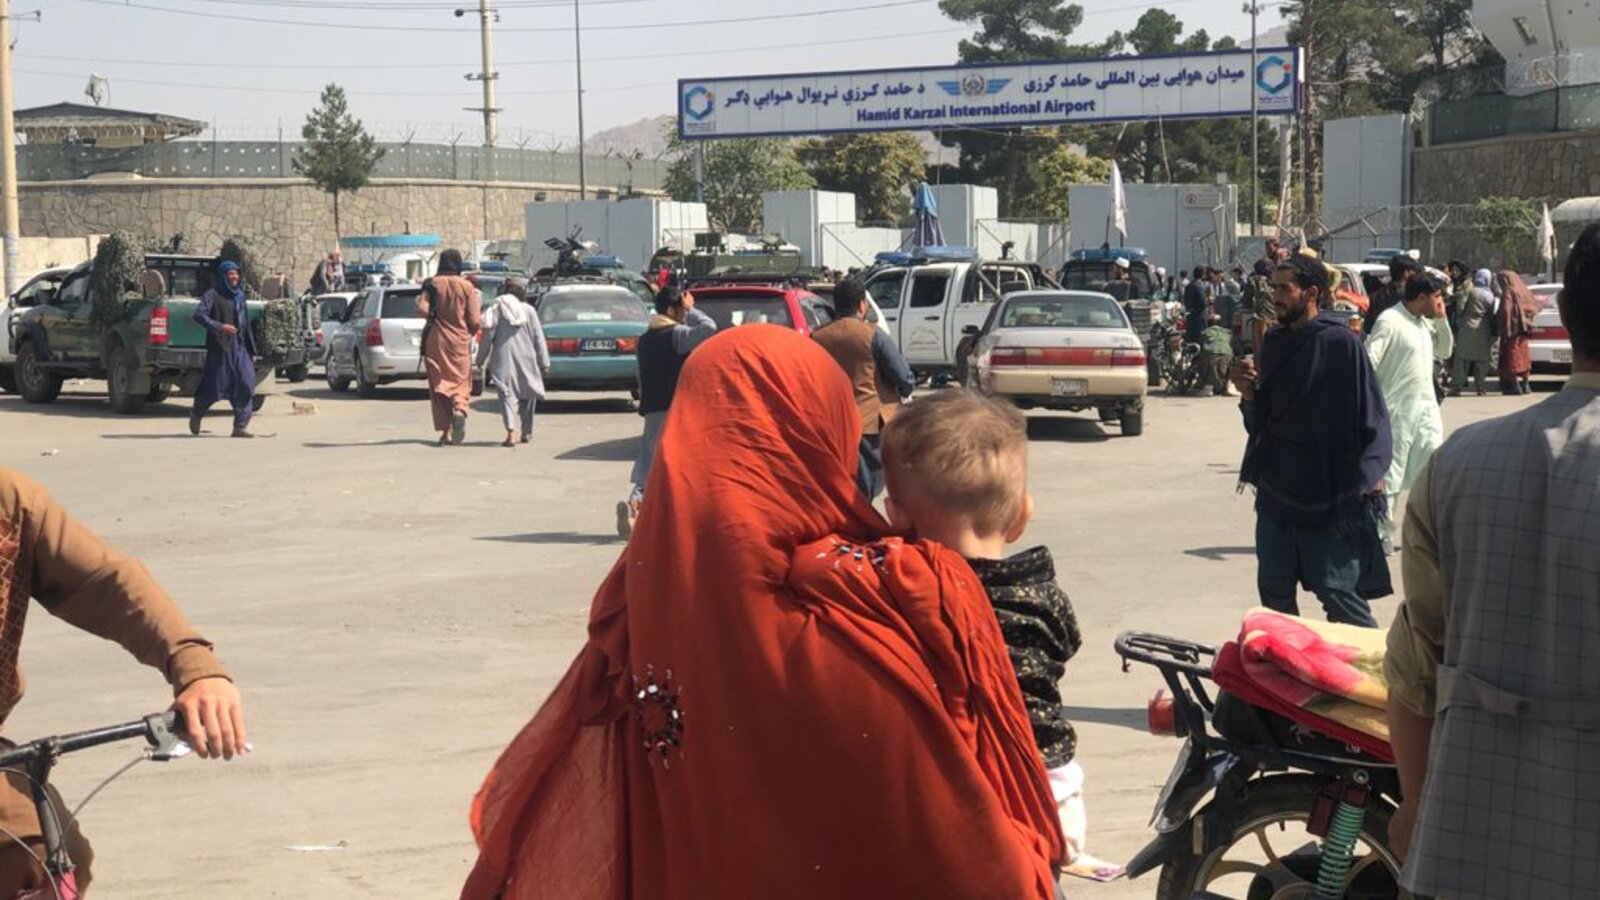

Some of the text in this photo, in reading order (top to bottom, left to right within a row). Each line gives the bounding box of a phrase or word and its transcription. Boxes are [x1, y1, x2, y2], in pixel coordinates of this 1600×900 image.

[883, 81, 914, 97] حامد
[916, 82, 926, 94] د
[1023, 65, 1246, 94] میدان هوایی بین المللی حامد کرزی
[857, 98, 1096, 123] Hamid Karzai International Airport
